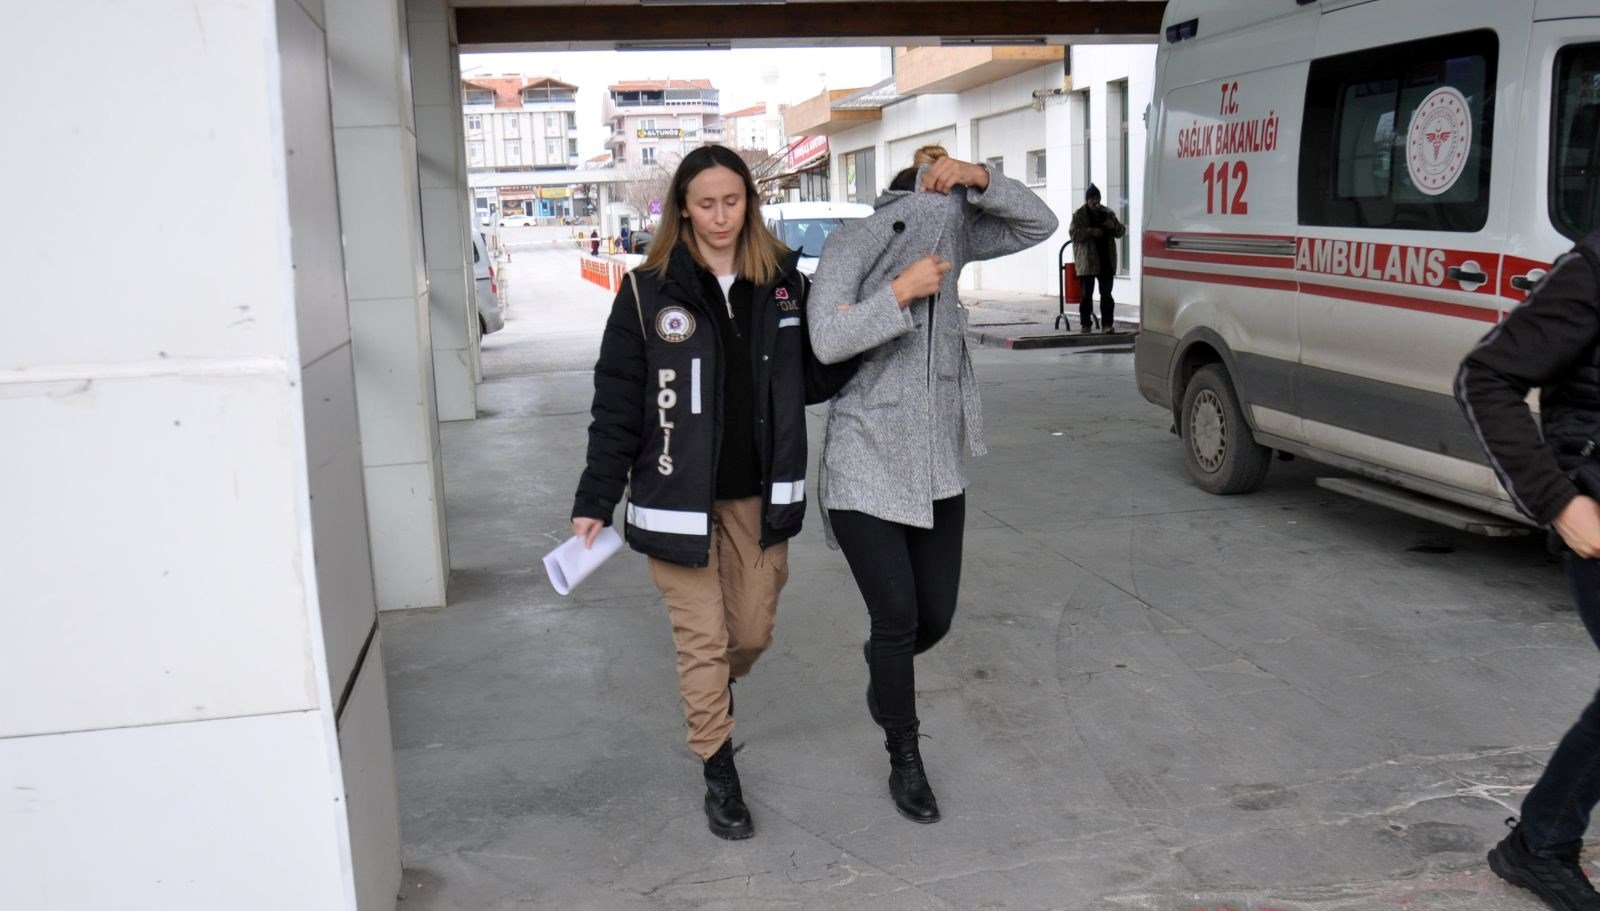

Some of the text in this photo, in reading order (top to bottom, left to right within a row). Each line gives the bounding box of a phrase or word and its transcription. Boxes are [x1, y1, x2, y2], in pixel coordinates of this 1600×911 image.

[1220, 81, 1239, 115] T.C.
[1177, 109, 1279, 158] SAĞLIK BAKANLIĞI
[1203, 160, 1248, 214] 112
[1296, 237, 1446, 286] AMBULANS
[657, 368, 677, 476] POLİS
